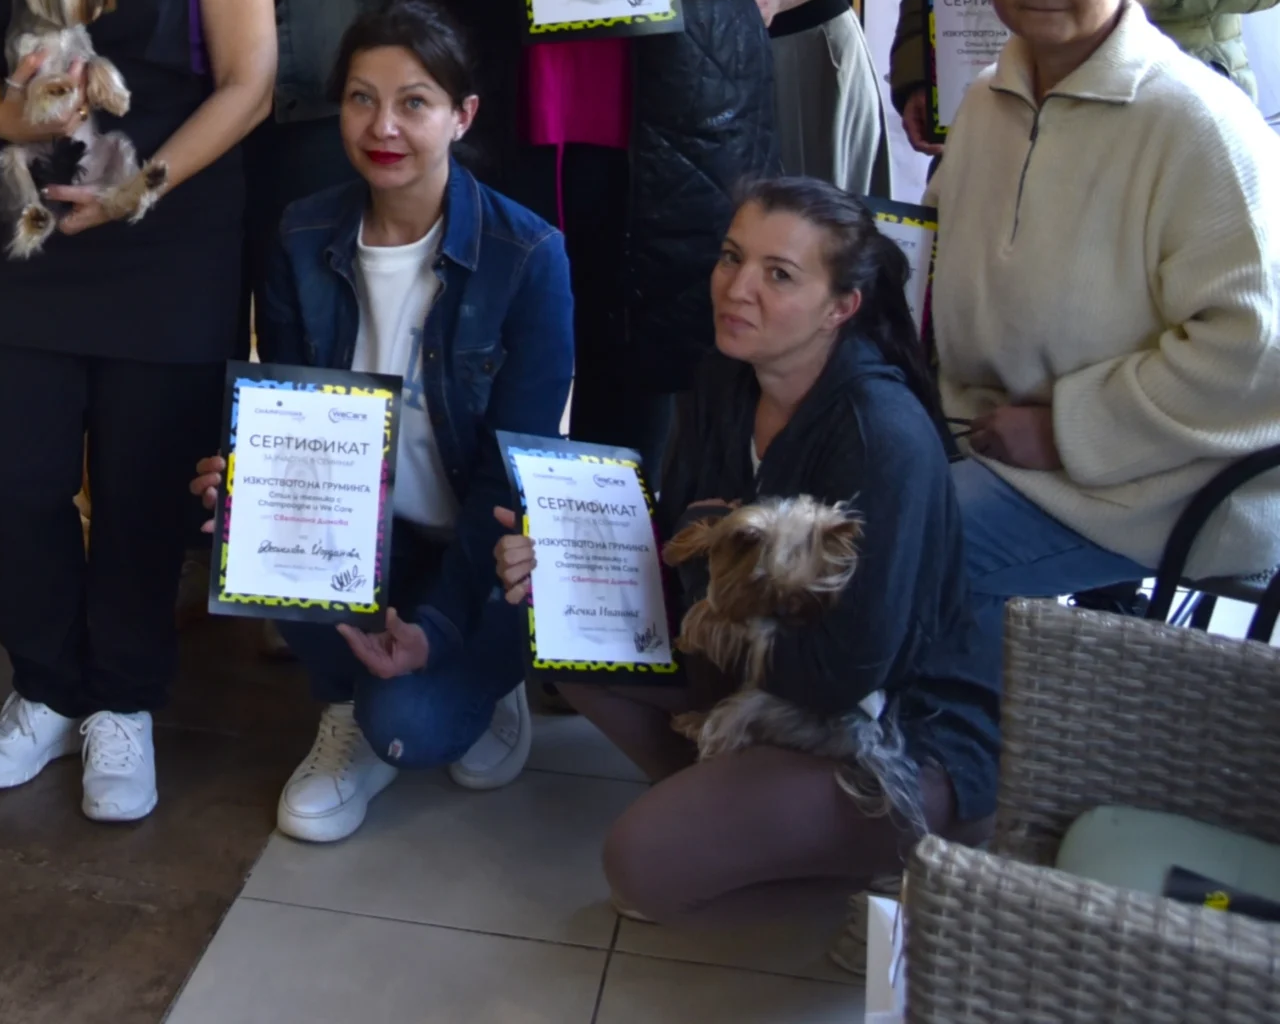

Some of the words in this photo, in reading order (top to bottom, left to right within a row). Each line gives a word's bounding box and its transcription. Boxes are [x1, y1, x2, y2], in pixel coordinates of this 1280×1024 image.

[248, 432, 370, 456] СЕРТИФИКАТ
[242, 475, 306, 488] ИЗКУСТВОТО
[306, 480, 320, 490] НА
[321, 481, 370, 494] ГРУМИНГА
[535, 495, 638, 517] СЕРТИФИКАТ
